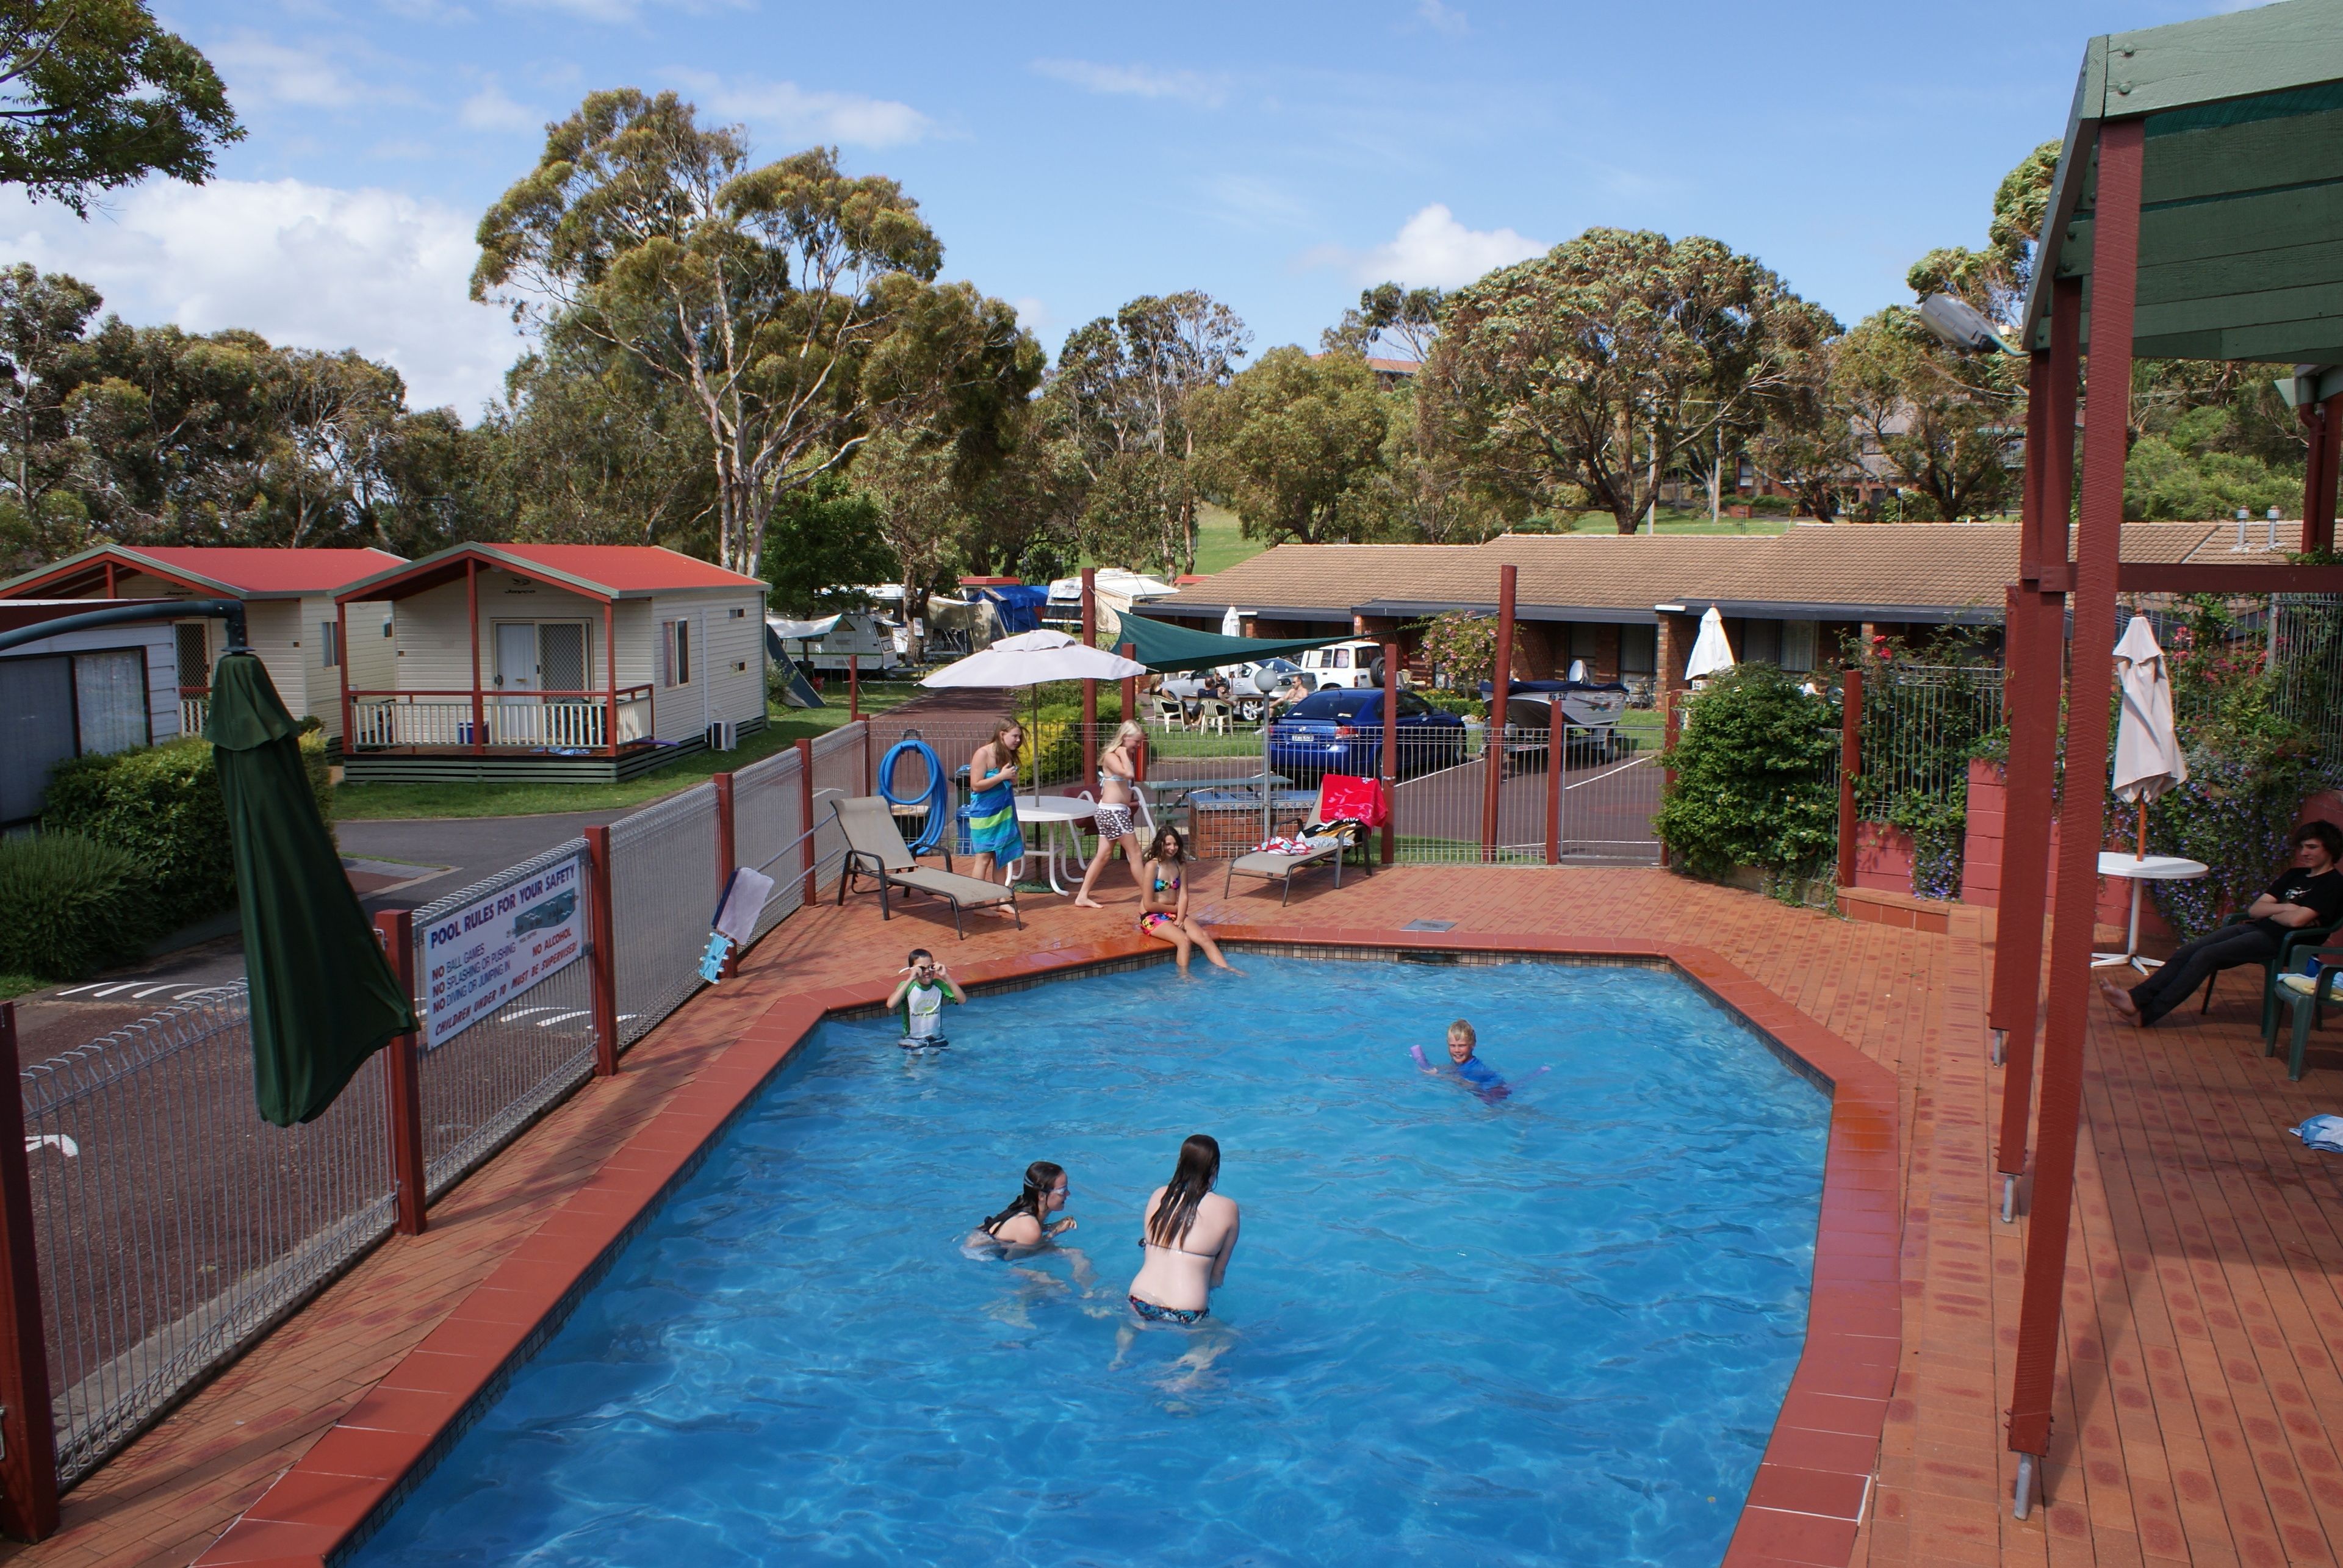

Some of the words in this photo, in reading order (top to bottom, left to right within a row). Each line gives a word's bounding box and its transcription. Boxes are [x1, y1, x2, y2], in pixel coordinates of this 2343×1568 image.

[431, 921, 461, 949] POOL
[464, 903, 494, 932] RULES
[497, 893, 516, 915] FOR
[519, 880, 542, 903] YOUR
[545, 864, 575, 891] SAFETY
[432, 965, 445, 981] NO
[446, 956, 462, 974] BALL
[464, 943, 484, 963] GAMES
[532, 943, 542, 957] NO
[544, 927, 572, 951] ALCOHOL
[433, 981, 445, 998] NO
[447, 962, 480, 990] SPLASHING
[481, 955, 491, 969] OR
[491, 942, 516, 964] PUSHING
[433, 998, 445, 1013] NO
[447, 985, 467, 1006] DIVING
[468, 979, 477, 993] OR
[479, 964, 503, 987] JUMPING
[436, 1005, 472, 1036] CHILDREN
[474, 990, 497, 1012] UNDER
[499, 984, 507, 996] 10
[511, 969, 529, 989] MUST
[531, 963, 539, 977] BE
